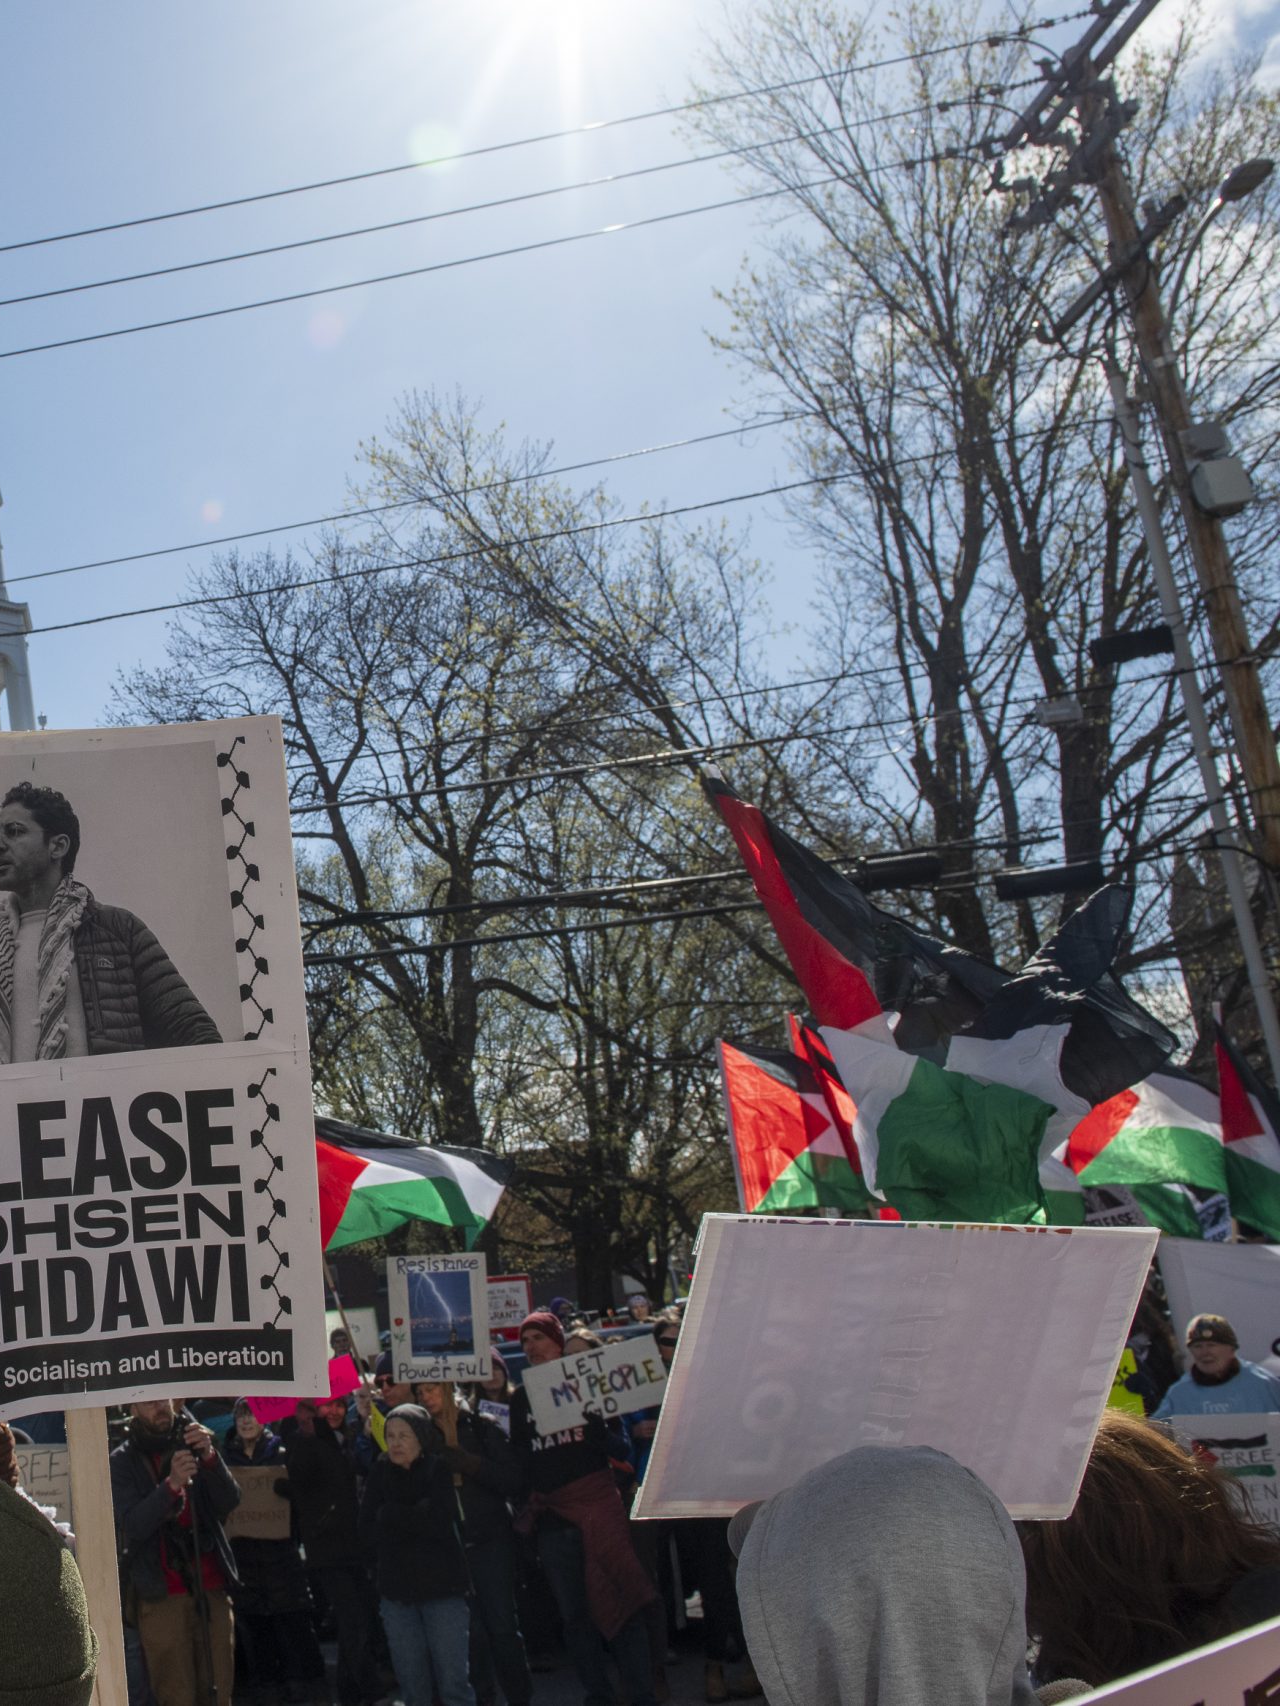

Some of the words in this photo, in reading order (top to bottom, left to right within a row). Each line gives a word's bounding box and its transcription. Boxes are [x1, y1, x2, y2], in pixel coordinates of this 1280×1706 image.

[4, 1358, 111, 1388] Socialism
[118, 1348, 161, 1374] and
[167, 1346, 285, 1369] Liberation
[561, 1351, 604, 1380] LET
[549, 1379, 583, 1407] MY
[586, 1358, 664, 1399] PEOPLE
[583, 1397, 618, 1417] GO
[531, 1426, 585, 1452] NAME
[17, 1449, 68, 1486] REE
[1220, 1448, 1275, 1466] FREE
